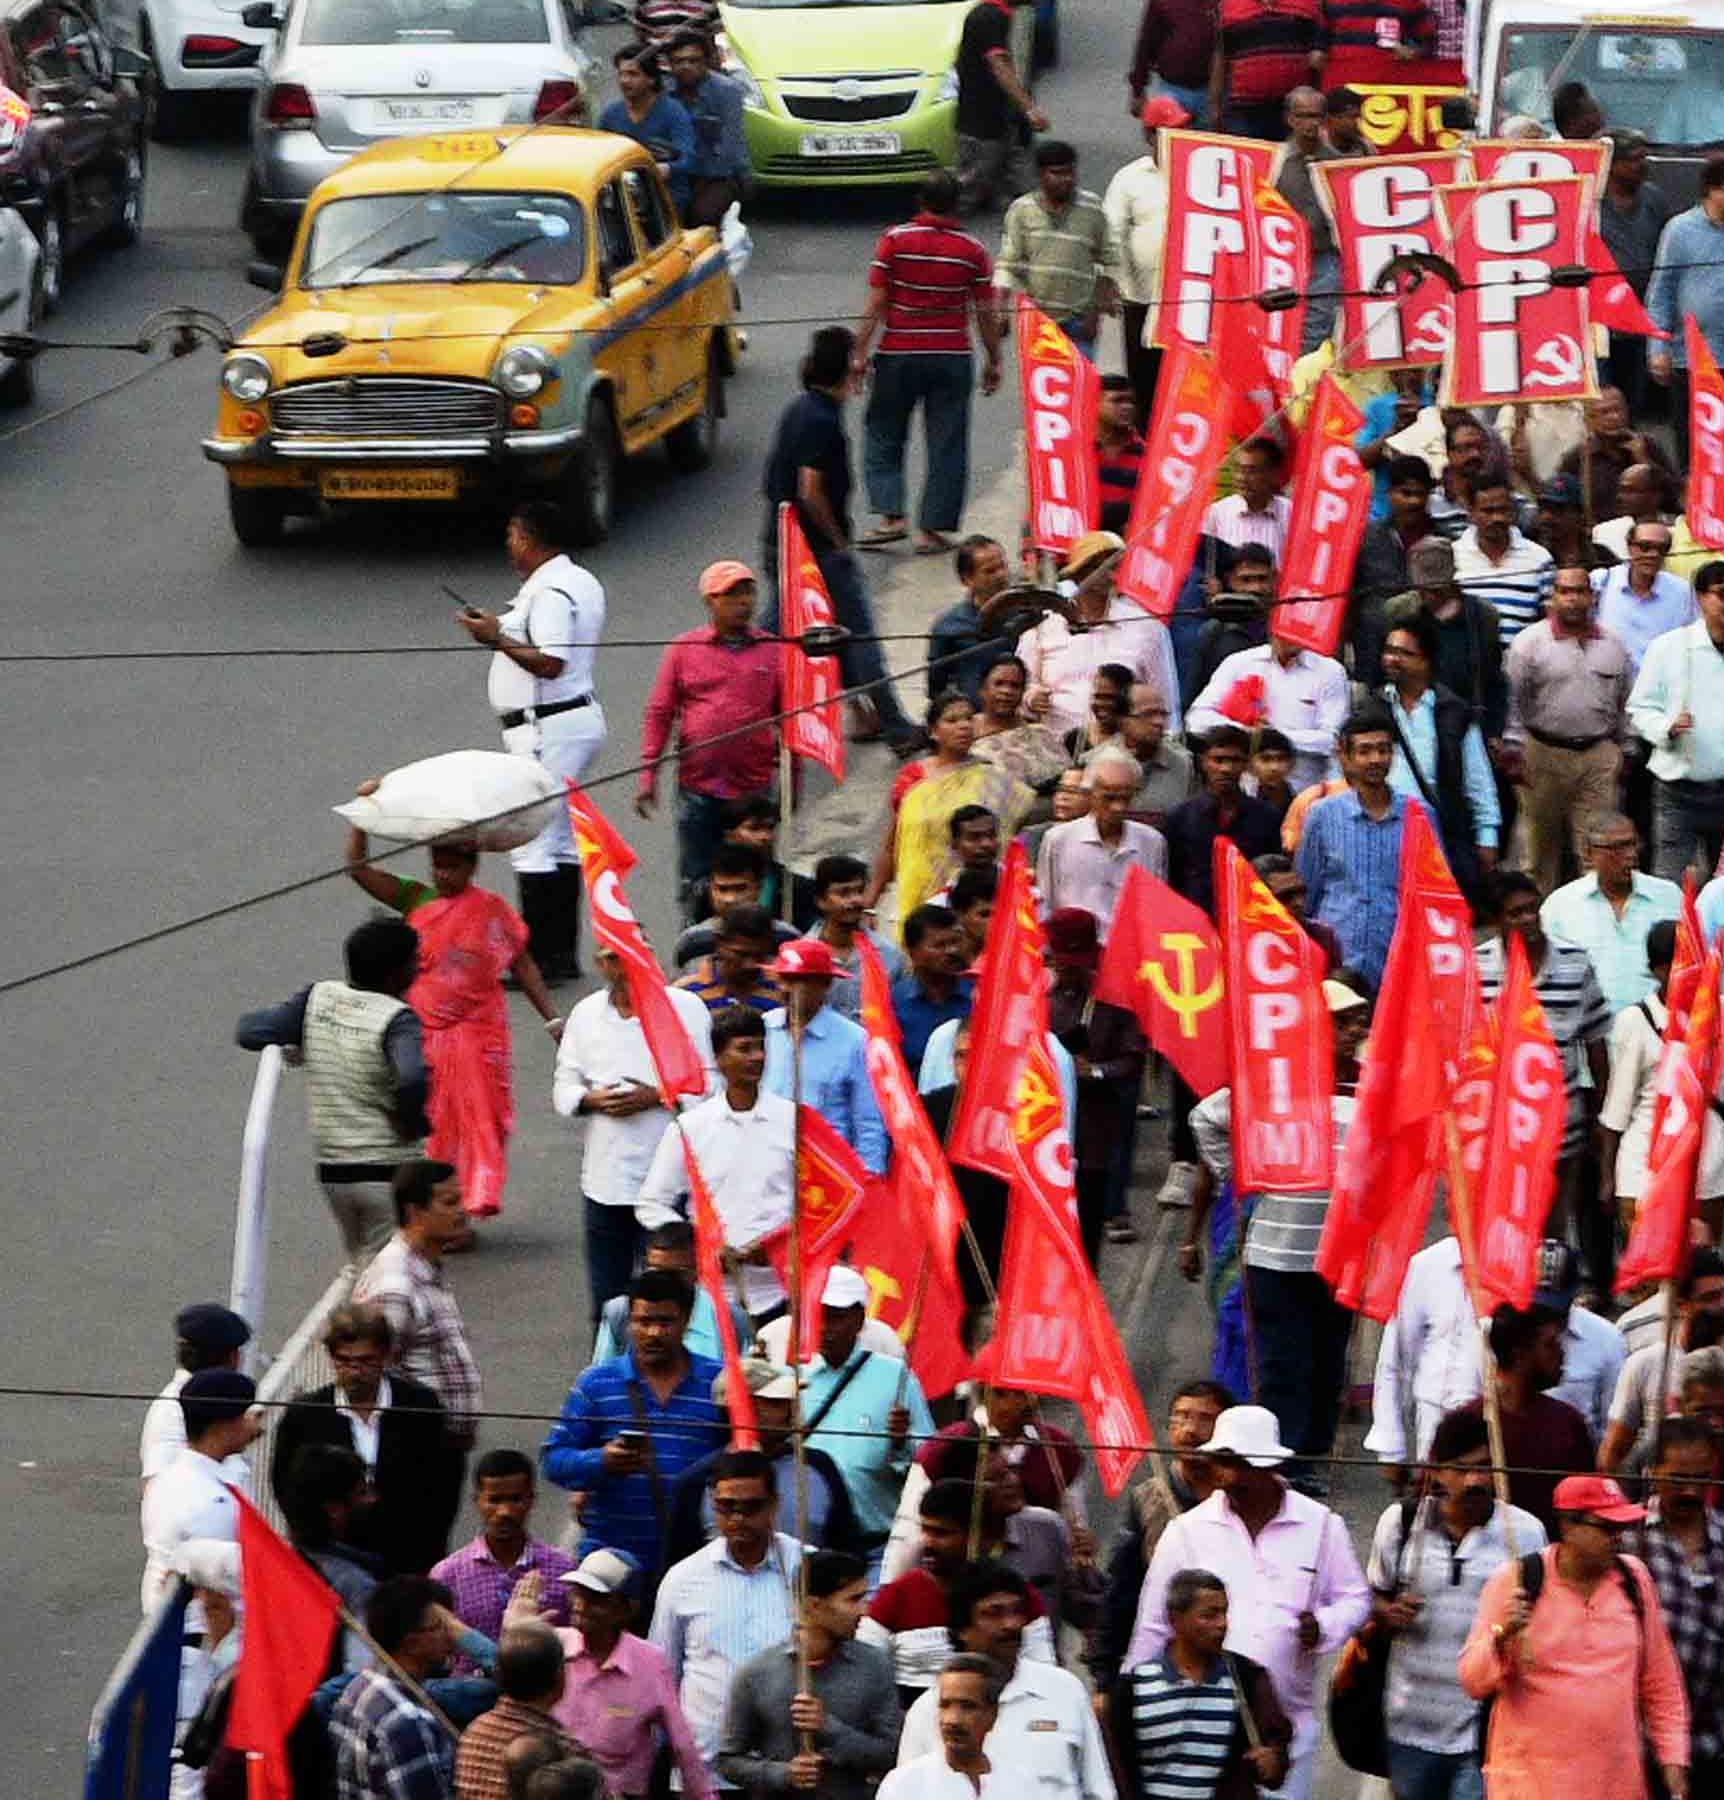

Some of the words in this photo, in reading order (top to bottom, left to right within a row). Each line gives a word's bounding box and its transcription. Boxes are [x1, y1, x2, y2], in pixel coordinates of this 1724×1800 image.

[1175, 146, 1246, 343] CPI
[1471, 186, 1558, 394] CPI
[1244, 932, 1321, 1170] CPI(M)
